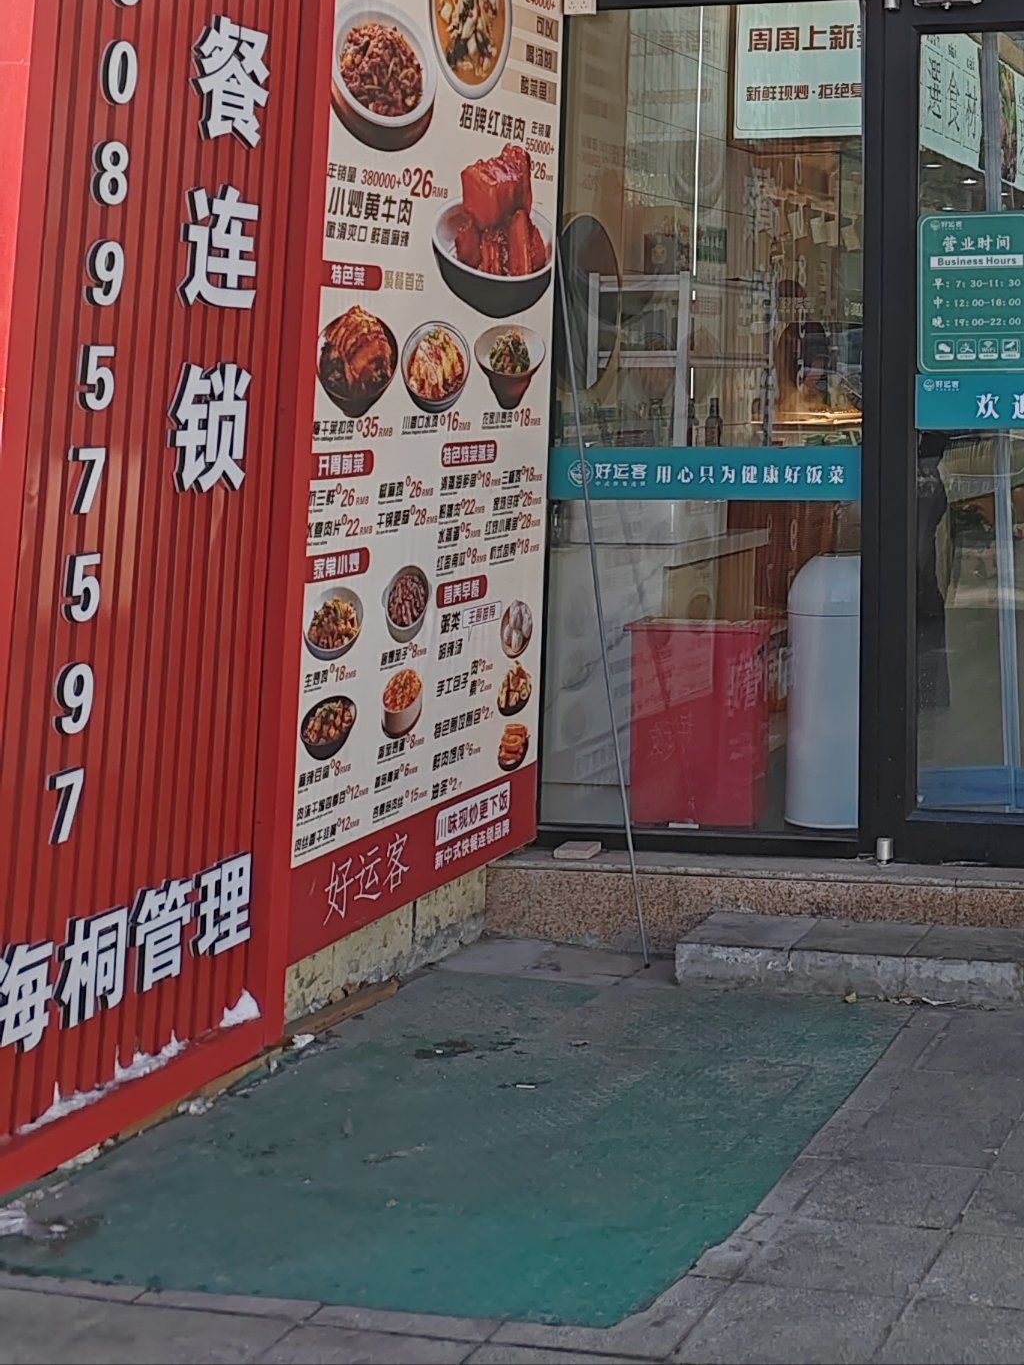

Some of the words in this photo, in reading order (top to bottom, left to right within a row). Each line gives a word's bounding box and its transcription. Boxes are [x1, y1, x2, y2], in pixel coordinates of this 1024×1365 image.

[747, 23, 862, 53] 周周上新
[459, 103, 526, 143] 招牌红烧肉
[525, 136, 554, 156] 550000+
[326, 162, 356, 183] 年销量
[360, 169, 401, 190] 380000+
[432, 186, 448, 199] RMB
[327, 186, 413, 226] 小炒黄牛肉
[942, 235, 1010, 252] 营业时间
[330, 264, 365, 286] 特色菜
[938, 257, 983, 266] Business
[986, 256, 1017, 265] Hours
[594, 463, 647, 480] 好运客
[655, 464, 845, 484] 用心只为健康好饭菜
[313, 551, 360, 580] 家常小炒
[437, 788, 508, 839] 川味现炒更下饭
[434, 824, 510, 870] 新中式快餐连锁品牌
[323, 832, 410, 926] 好运客
